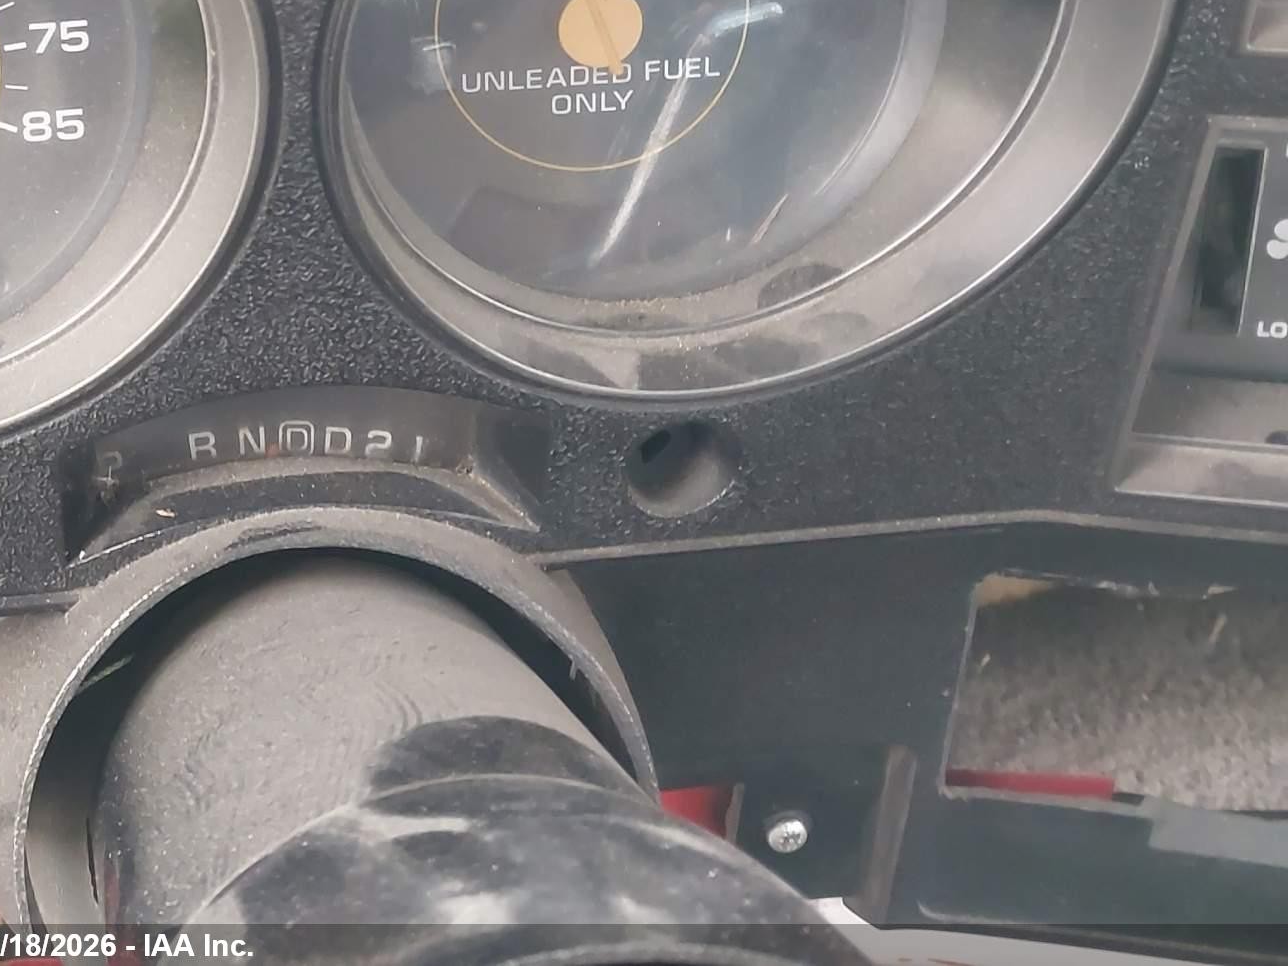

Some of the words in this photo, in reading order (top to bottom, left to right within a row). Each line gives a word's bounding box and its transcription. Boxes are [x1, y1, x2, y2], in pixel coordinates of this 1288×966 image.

[28, 20, 89, 54] 75
[462, 64, 632, 94] UNLEADED
[645, 56, 721, 82] FUEL
[551, 89, 634, 115] ONLY
[22, 108, 85, 143] 85
[188, 431, 217, 461] R
[238, 426, 266, 455] N
[324, 427, 352, 455] D
[364, 430, 392, 456] 2
